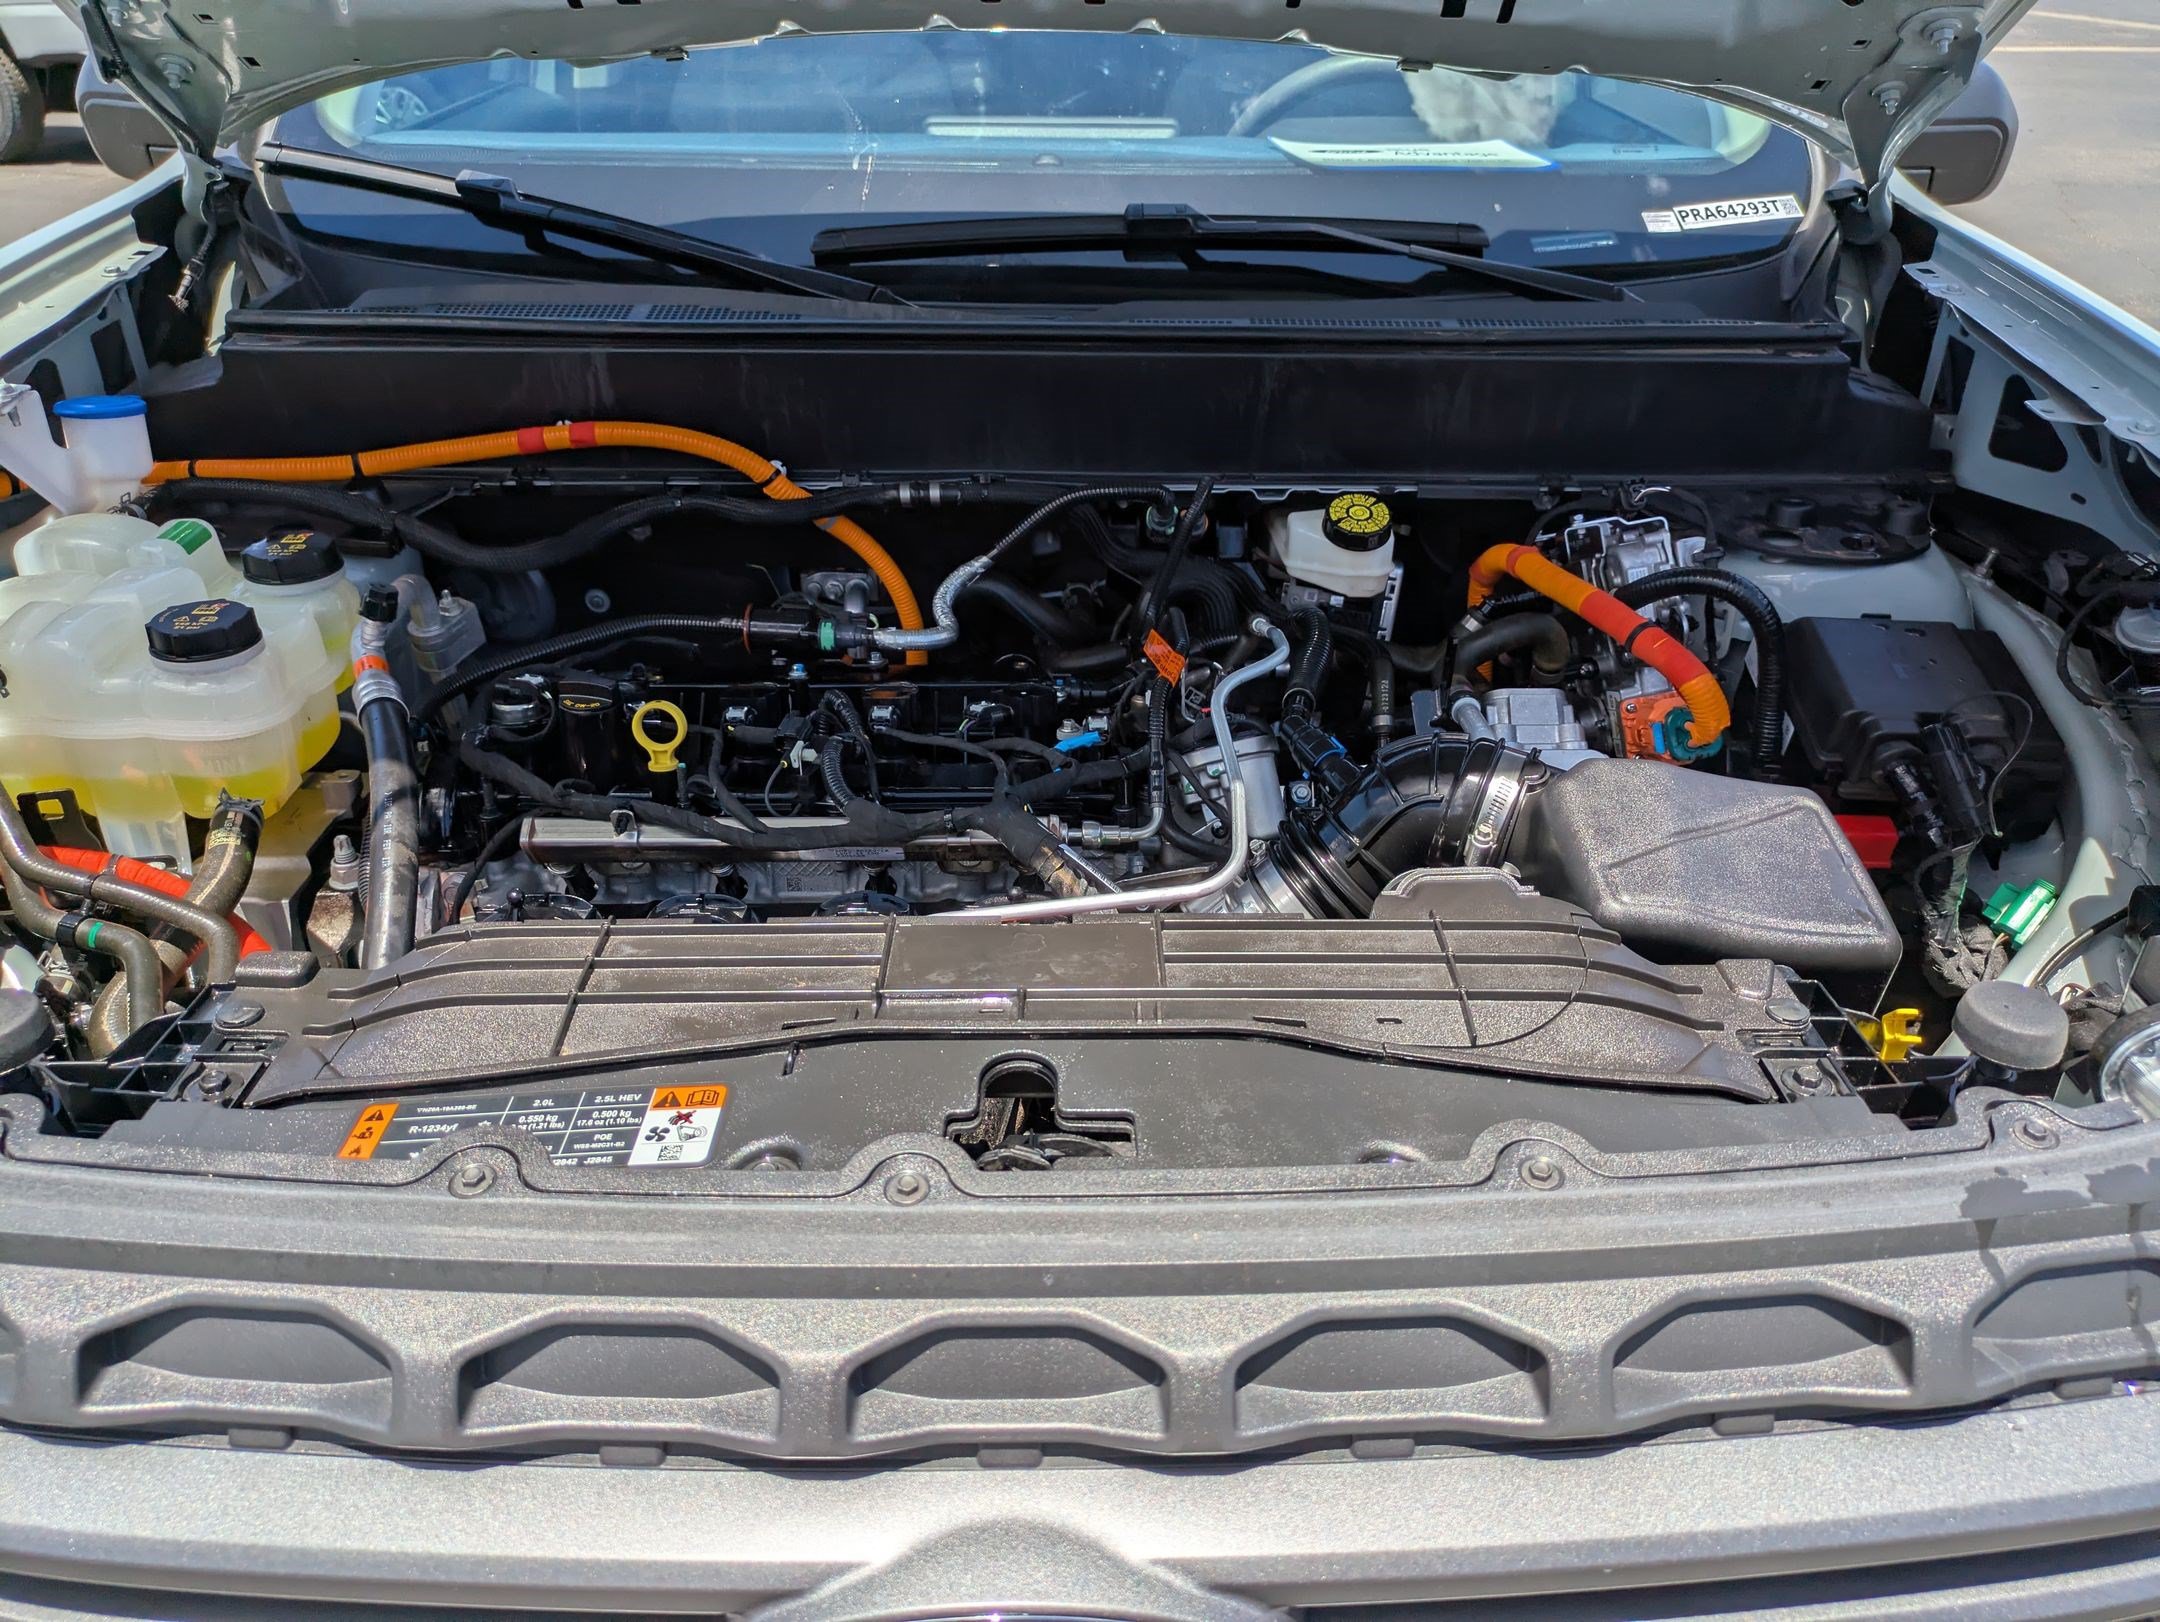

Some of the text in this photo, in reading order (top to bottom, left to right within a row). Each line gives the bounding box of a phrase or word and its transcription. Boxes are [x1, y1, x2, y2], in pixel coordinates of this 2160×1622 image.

[1677, 199, 1781, 223] PRA64293T
[532, 1099, 555, 1107] 2.0L
[594, 1094, 642, 1103] 2.5L HEV
[518, 1114, 559, 1124] 0.550 kg
[592, 1110, 632, 1119] 0.500 kg
[408, 1122, 460, 1134] R-1234yf
[593, 1133, 613, 1142] POE
